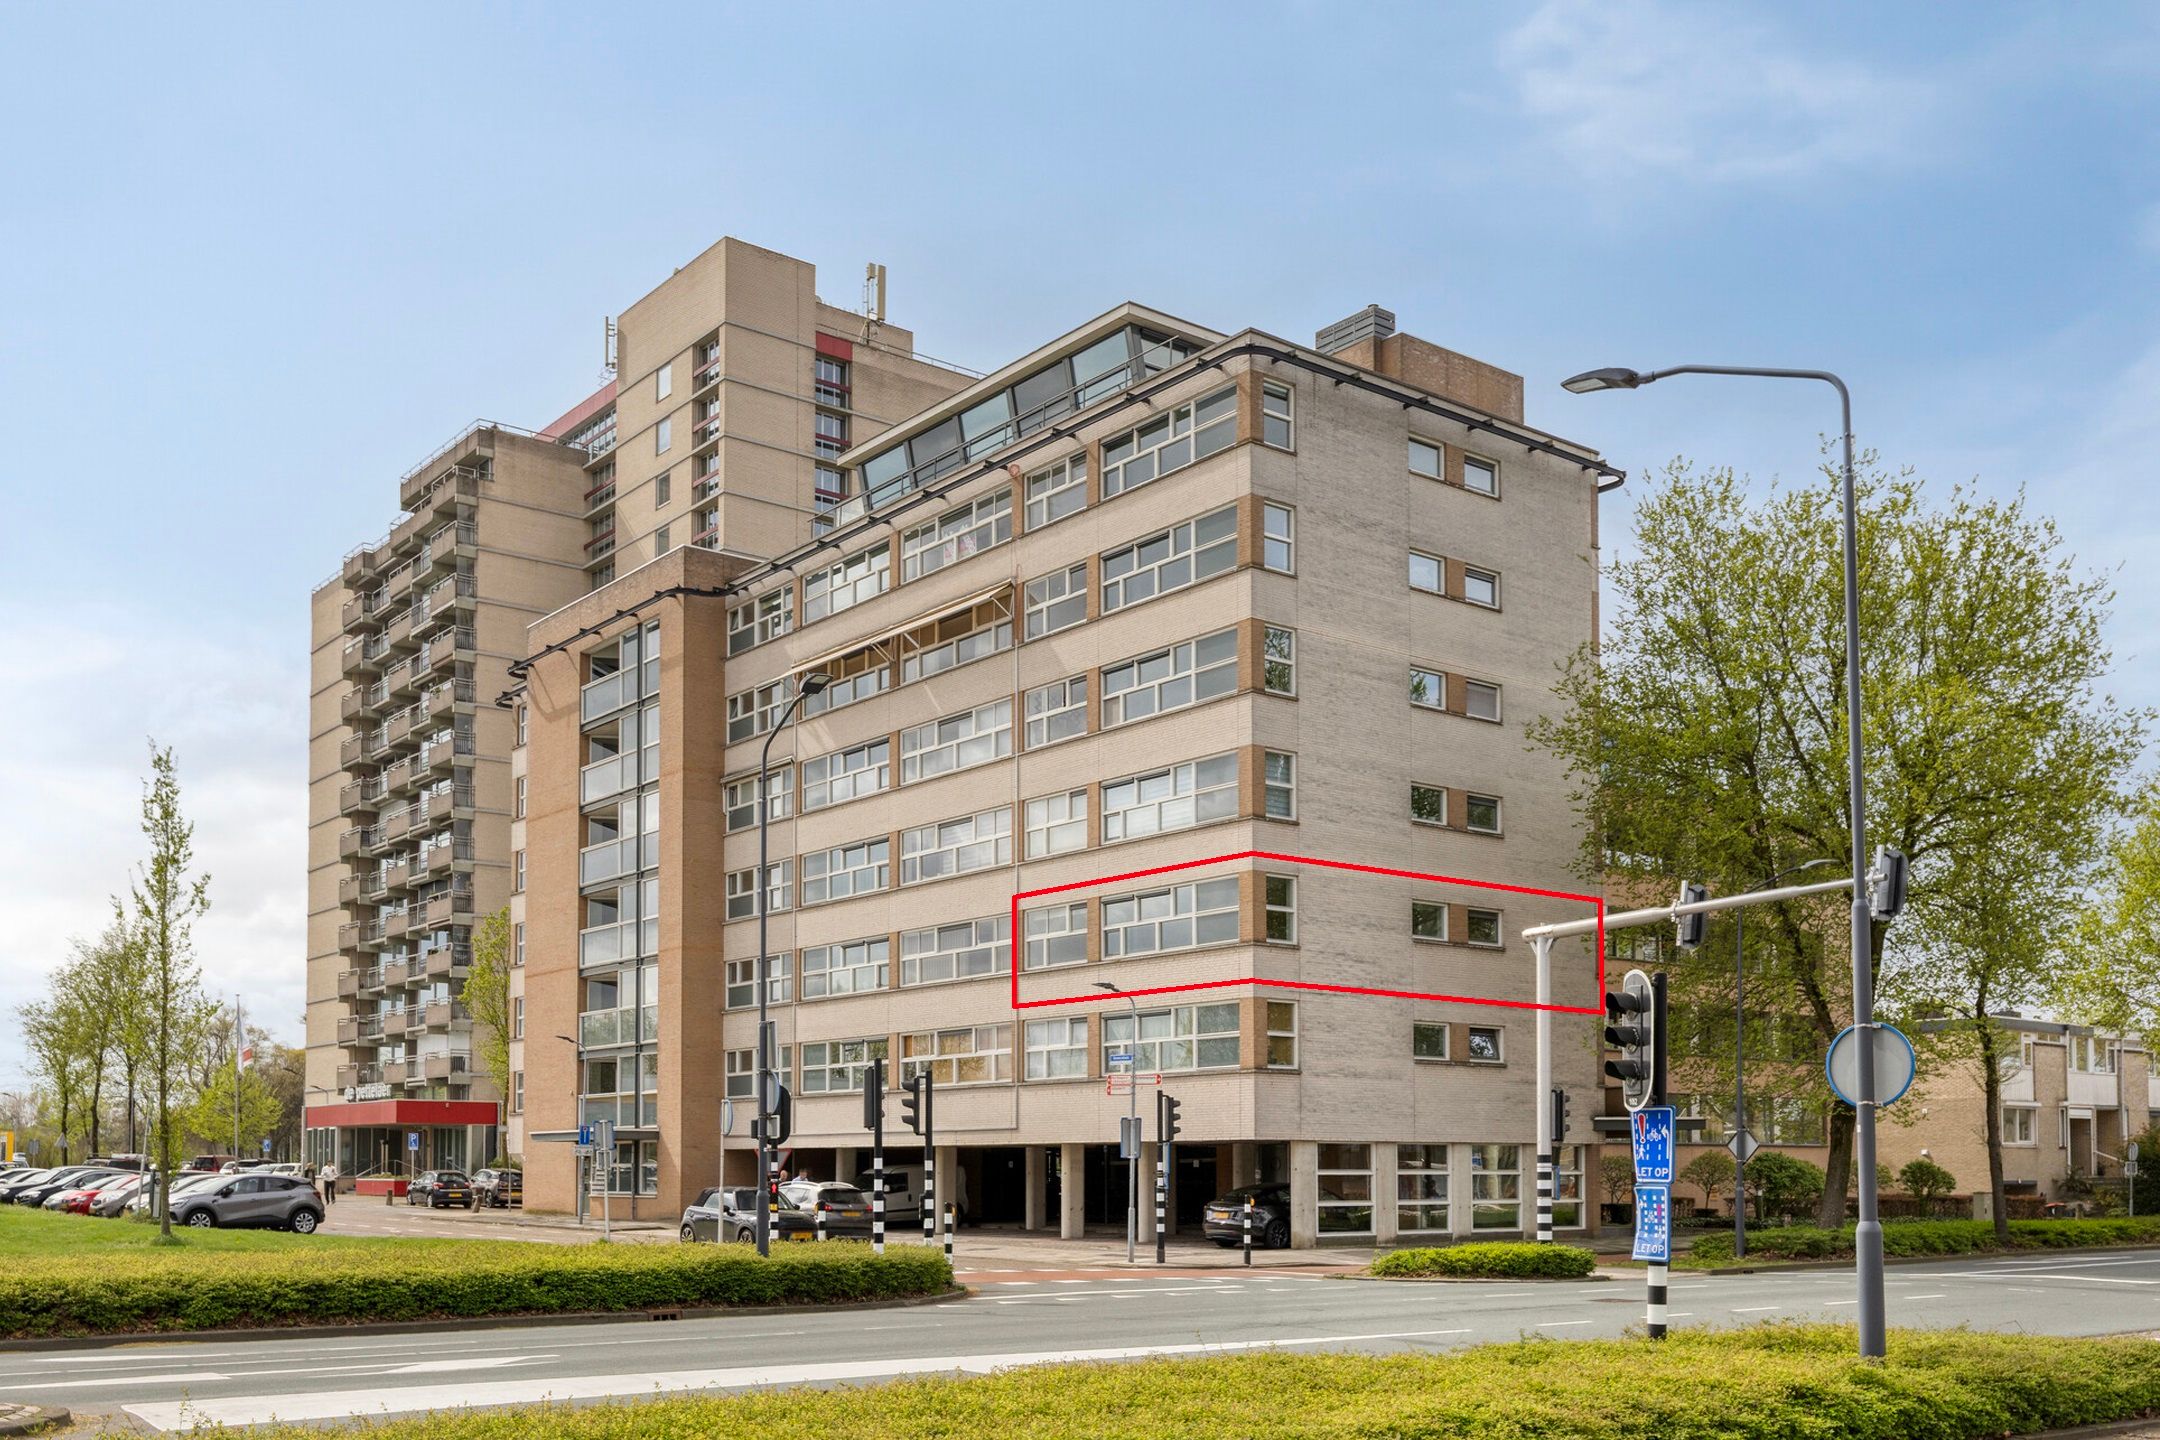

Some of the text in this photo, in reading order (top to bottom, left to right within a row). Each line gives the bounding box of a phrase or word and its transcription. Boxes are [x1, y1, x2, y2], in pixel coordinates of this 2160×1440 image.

[1637, 1167, 1669, 1177] LET OP
[1636, 1243, 1665, 1254] LET OP
